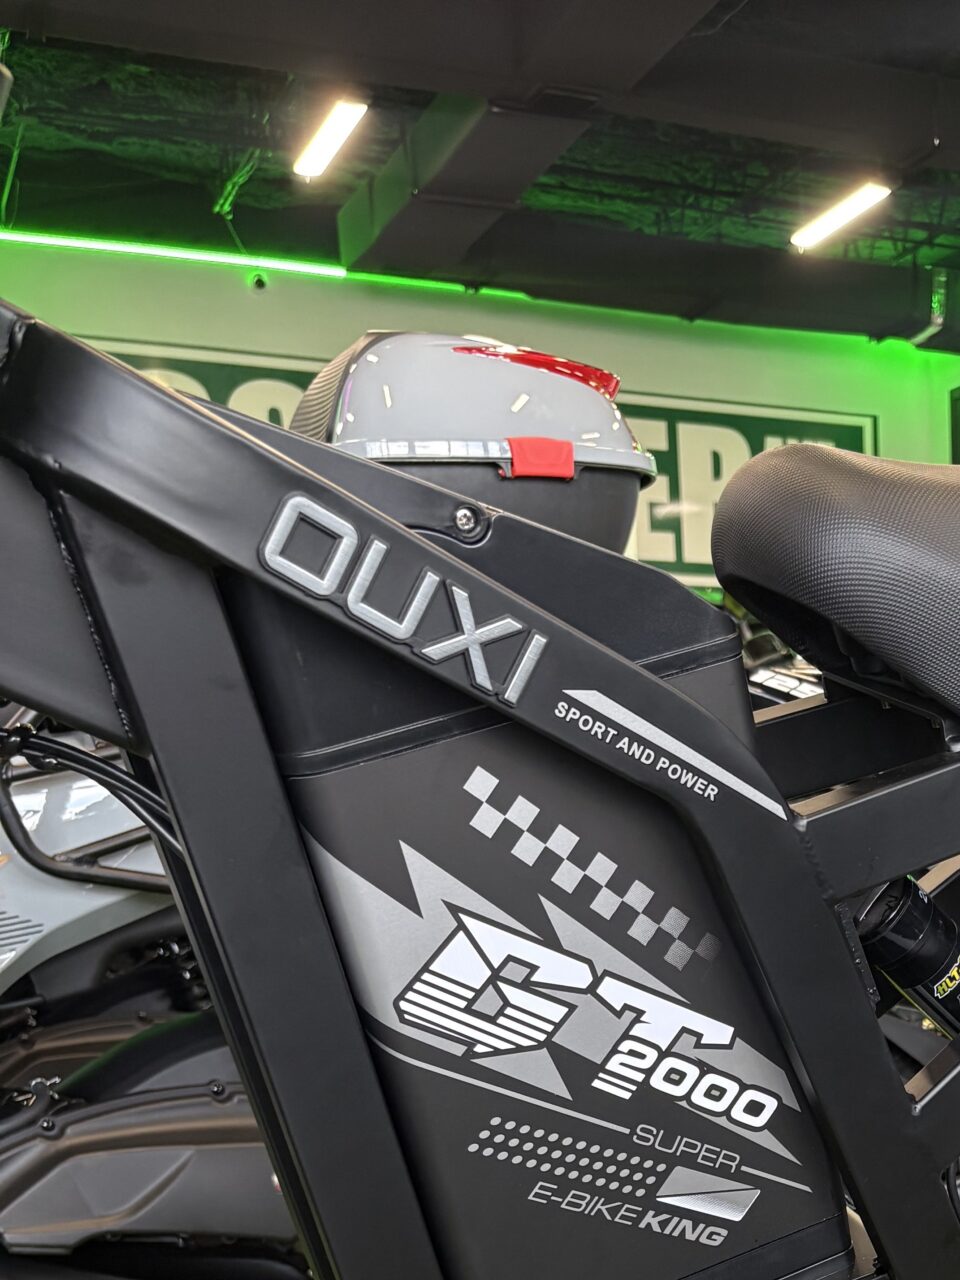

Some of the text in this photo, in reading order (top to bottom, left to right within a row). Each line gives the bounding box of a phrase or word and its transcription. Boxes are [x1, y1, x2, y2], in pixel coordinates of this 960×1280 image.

[259, 496, 548, 702] OUXI
[554, 701, 719, 801] SPORT AND POWER
[604, 1040, 778, 1128] 2000
[633, 1124, 740, 1173] SUPER
[527, 1181, 729, 1246] E-BIKE KING
